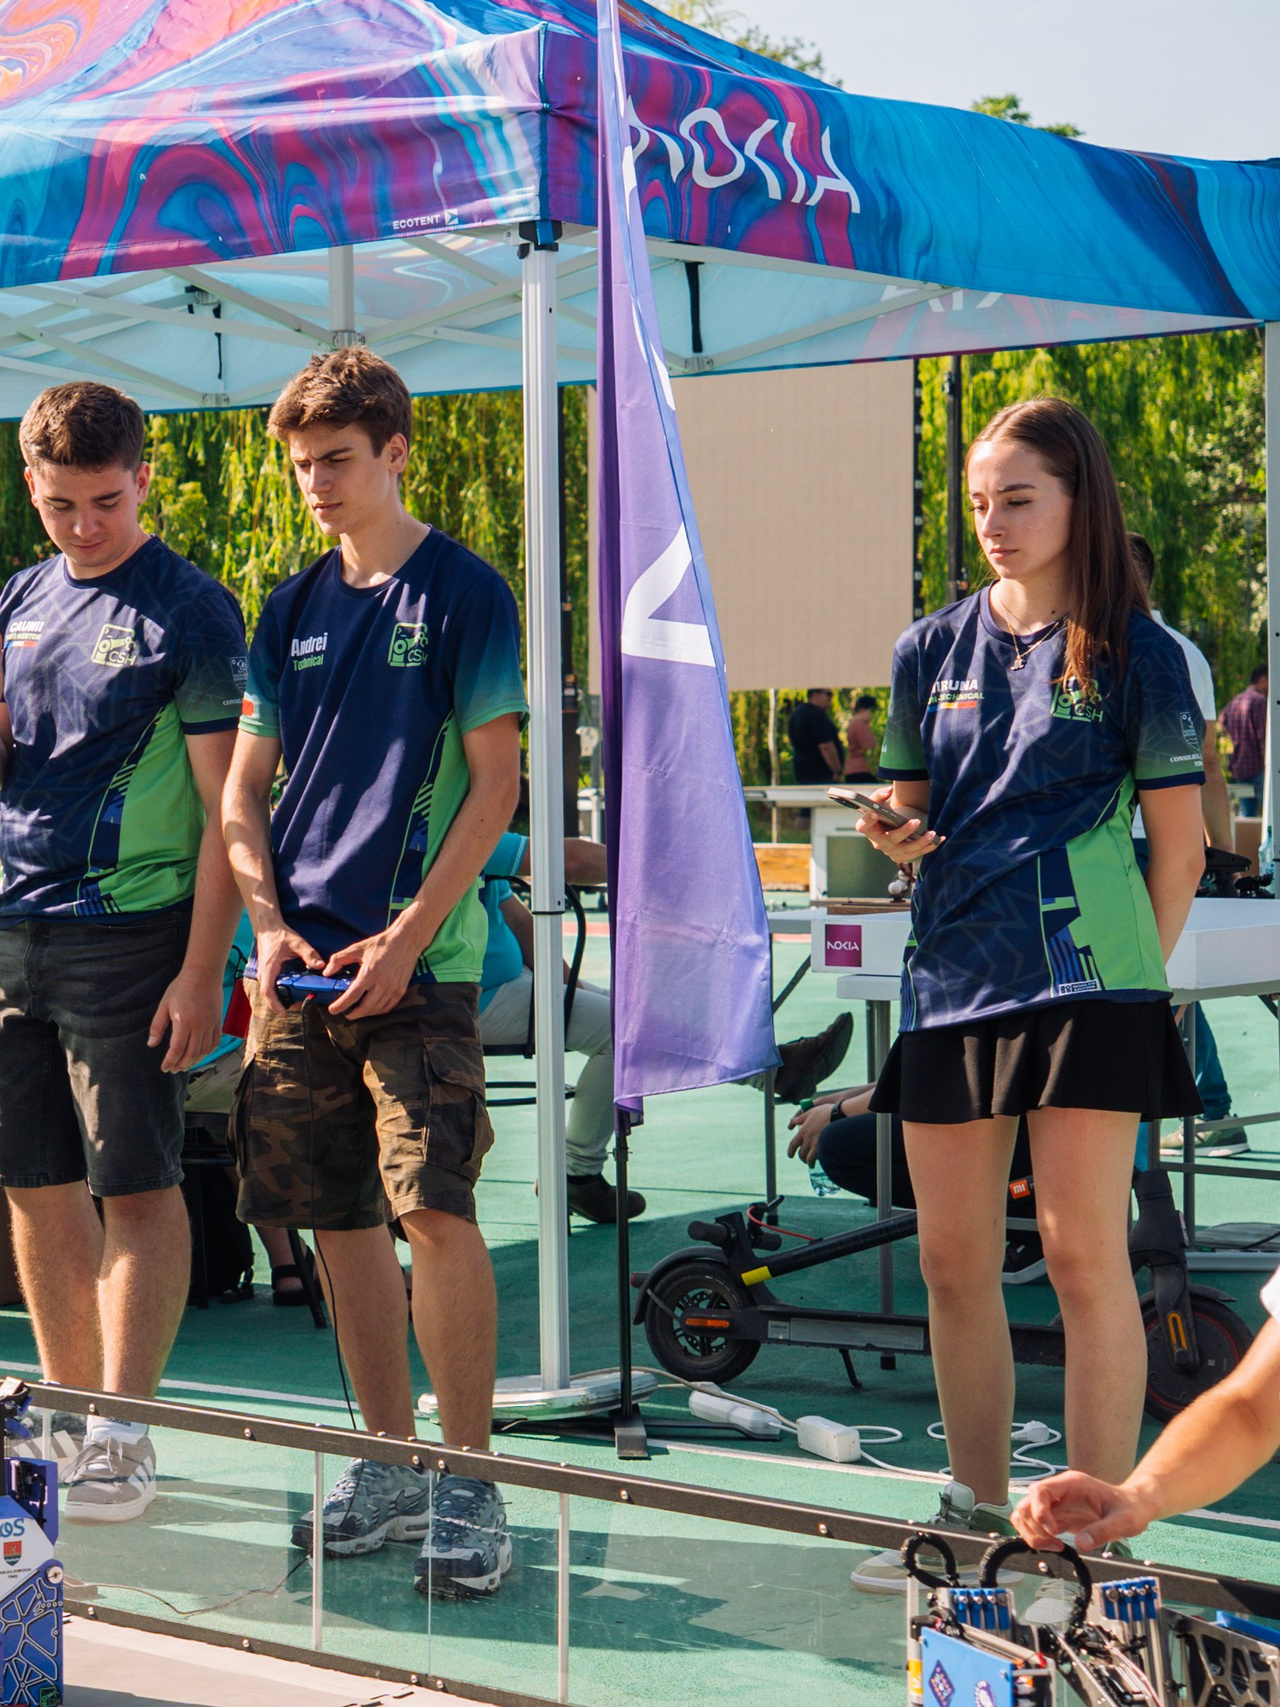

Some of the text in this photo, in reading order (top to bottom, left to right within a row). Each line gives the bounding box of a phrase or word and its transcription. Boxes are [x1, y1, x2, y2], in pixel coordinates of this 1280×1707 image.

[628, 94, 861, 214] NOKIA
[392, 214, 440, 230] ECOTENT
[290, 632, 328, 657] Andrei
[108, 651, 137, 666] CSH
[293, 653, 325, 672] Technical
[407, 649, 428, 665] CSH
[826, 940, 860, 951] NOKIA
